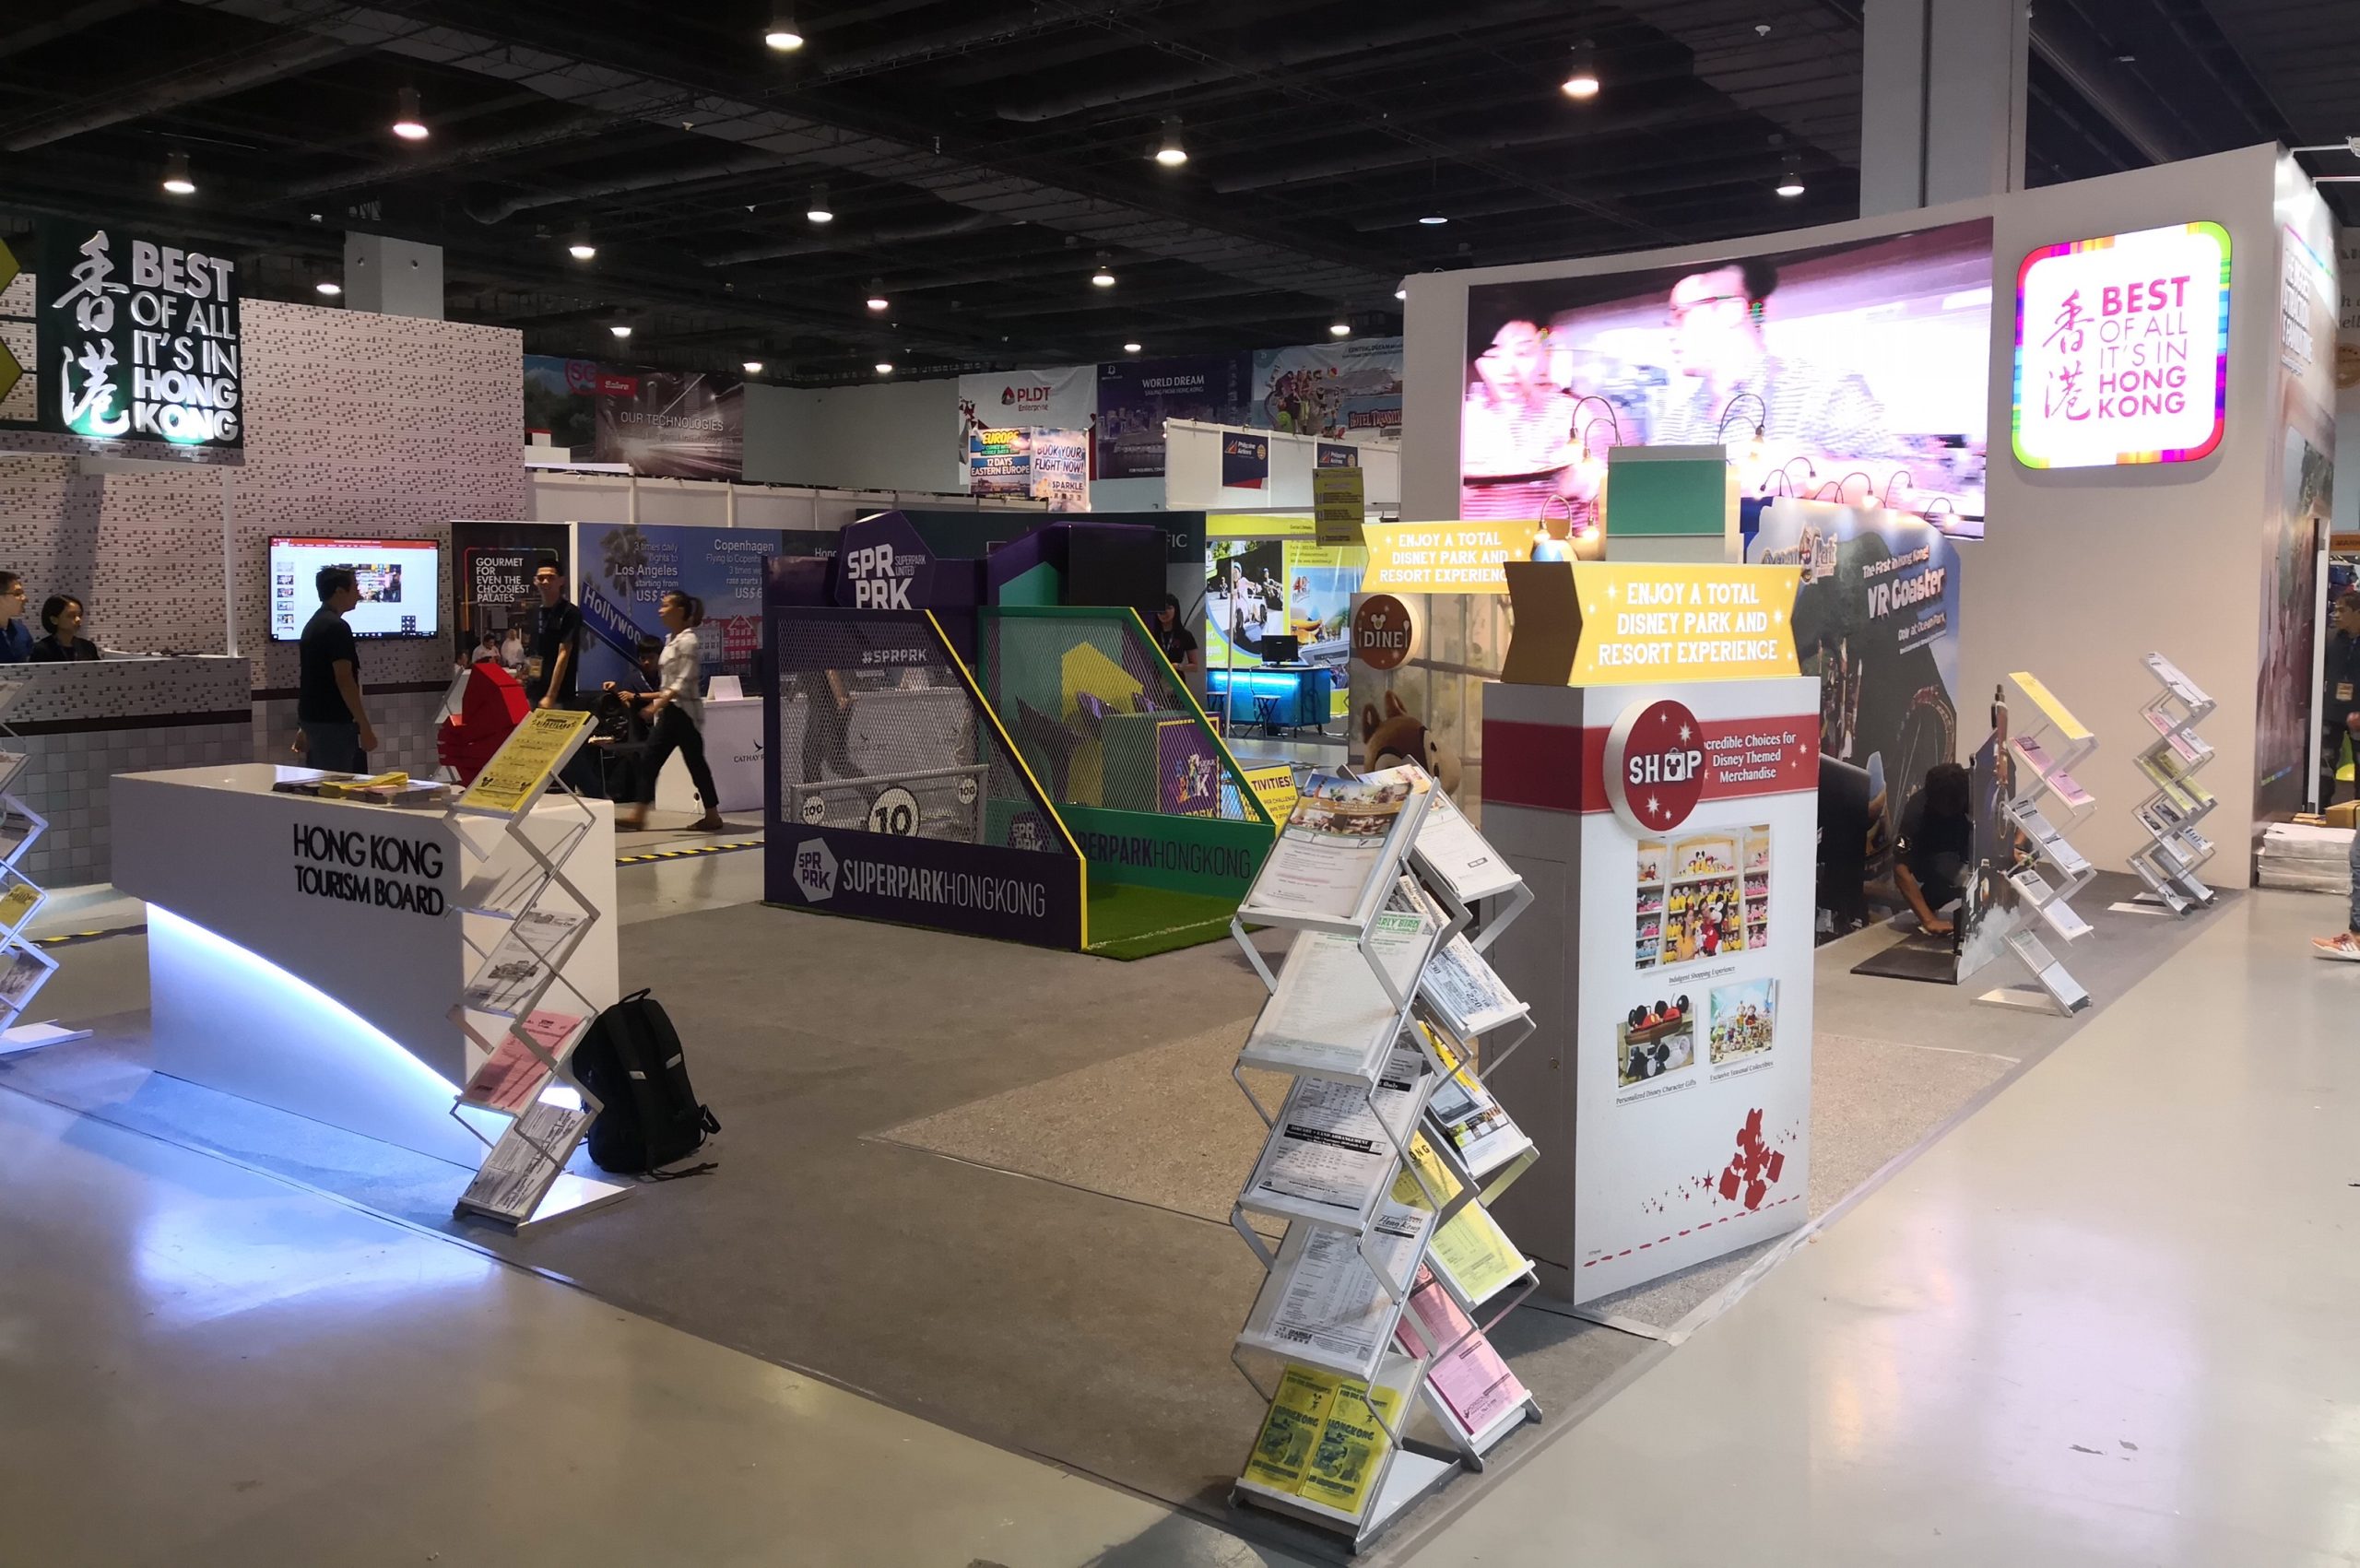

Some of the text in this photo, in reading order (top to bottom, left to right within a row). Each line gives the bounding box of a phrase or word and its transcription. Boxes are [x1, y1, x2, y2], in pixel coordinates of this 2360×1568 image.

[132, 240, 234, 302] BEST
[2102, 276, 2190, 317] BEST
[131, 290, 236, 340] OF ALL
[53, 230, 130, 436] 香港
[2099, 311, 2188, 343] OF ALL
[134, 329, 238, 379] IT'S IN
[2042, 289, 2095, 421] 香港
[2100, 338, 2188, 369] IT'S IN
[134, 366, 238, 409] HONG
[1142, 374, 1205, 388] WORLD DREAM
[2098, 365, 2187, 394] HONG
[1017, 386, 1051, 403] PLDT
[1018, 404, 1049, 412] Enterprise
[2098, 391, 2186, 419] KONG
[133, 400, 239, 442] KONG
[620, 411, 724, 431] OUR TECHNOLOGIES
[982, 430, 1020, 445] EUROPE
[1037, 445, 1082, 458] BOOK YOUR
[986, 457, 1013, 466] 12 DAYS
[1034, 458, 1084, 474] FLIGHT NOW!
[971, 465, 1030, 476] EASTERN EUROPE
[1052, 480, 1083, 490] SPARKLE
[714, 538, 774, 553] Copenhagen
[1398, 532, 1502, 547] ENJOY A TOTAL
[476, 557, 524, 567] GOURMET
[706, 553, 726, 564] Flying
[734, 554, 761, 564] Copenha
[847, 543, 895, 580] SPR
[894, 554, 926, 566] SUPERPARK
[1392, 549, 1508, 565] DISNEY PARK AND
[476, 566, 496, 576] FOR
[615, 564, 678, 579] Los Angeles
[894, 565, 915, 576] UNITED
[1380, 568, 1508, 584] RESORT EXPERIENC
[1862, 564, 1875, 579] The
[1875, 559, 1891, 574] First
[476, 575, 522, 584] EVEN THE
[634, 578, 679, 590] starting from
[477, 584, 530, 594] CHOOSIEST
[636, 588, 657, 603] US$
[735, 586, 755, 599] US$
[856, 578, 913, 610] PRK
[1626, 583, 1760, 605] ENJOY A TOTAL
[1868, 567, 1945, 620] VR Coaster
[477, 594, 515, 603] PALATES
[584, 587, 643, 645] Hollywoo
[1617, 611, 1767, 635] DISNEY PARK AND
[1363, 631, 1403, 647] DINE
[862, 648, 927, 665] #SPRPRK
[1599, 640, 1778, 666] RESORT EXPERIENCE
[1704, 731, 1797, 750] credible Choices for
[734, 754, 761, 763] CATHAY
[1629, 749, 1702, 784] SHOP
[1713, 749, 1781, 768] Disney Themed
[1251, 775, 1293, 792] TIVITIES!
[1719, 767, 1776, 784] Merchandise
[959, 785, 976, 797] 100
[803, 804, 823, 817] 100
[876, 804, 913, 835] 10
[1012, 821, 1035, 838] SPR
[293, 823, 443, 879] HONG KONG
[1072, 831, 1251, 879] PERPARKHONGKONG
[798, 851, 821, 869] SPR
[802, 869, 831, 892] PRK
[843, 858, 1045, 918] SUPERPARKHONGKONG
[295, 865, 444, 916] TOURISM BOARD
[1691, 971, 1711, 981] Shopping
[1711, 966, 1736, 977] Experience
[1615, 1079, 1696, 1105] Personalized Disney Character Gifts
[1409, 1144, 1430, 1161] ONG
[1328, 1419, 1375, 1441] HONGKONG
